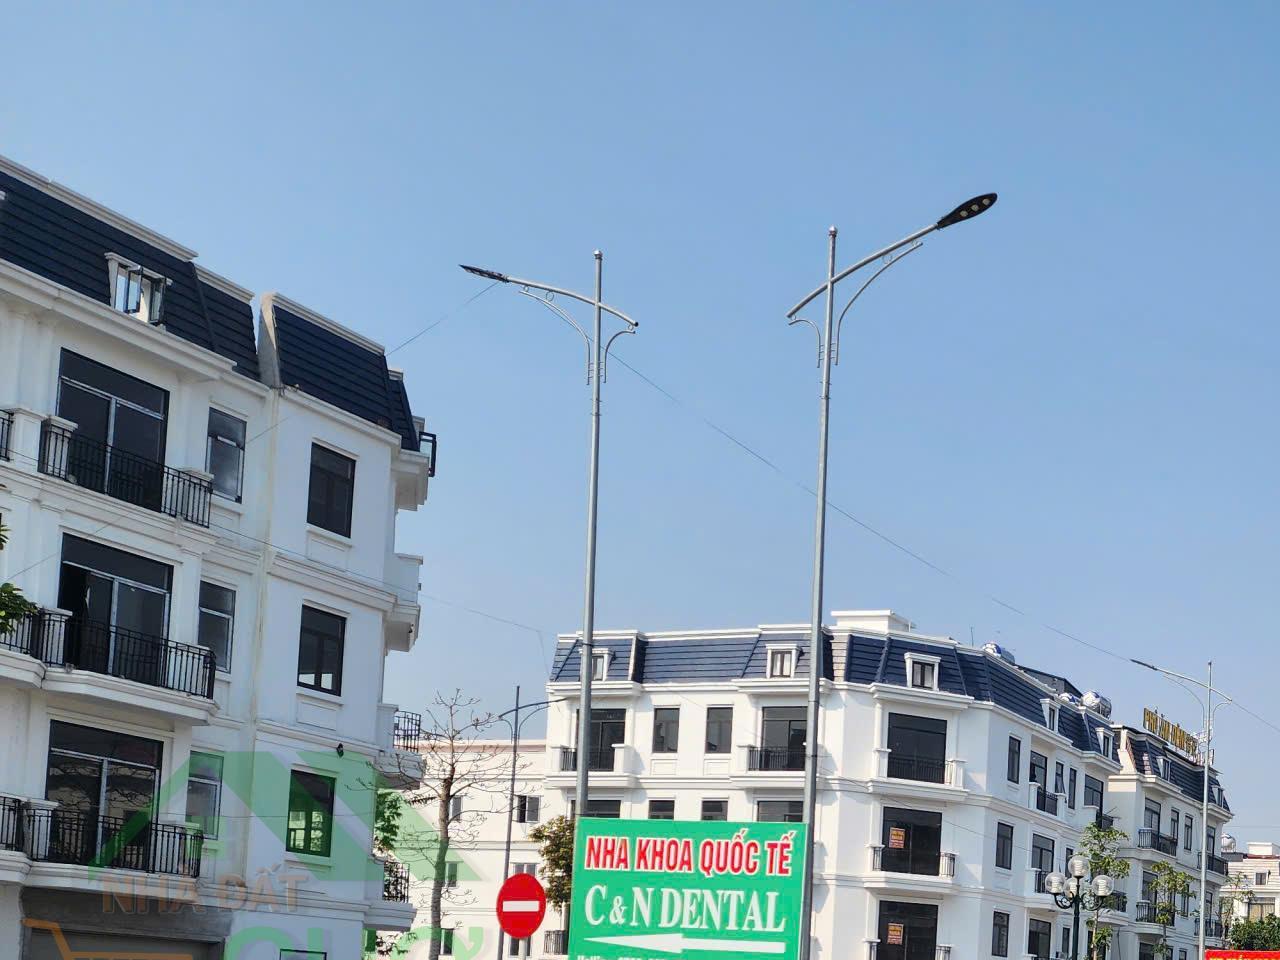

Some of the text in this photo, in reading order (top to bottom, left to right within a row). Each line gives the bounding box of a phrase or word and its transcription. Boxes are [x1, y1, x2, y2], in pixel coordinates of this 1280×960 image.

[585, 828, 797, 877] NHA KHOA QUỐC TẾ
[658, 888, 786, 932] DENTAL
